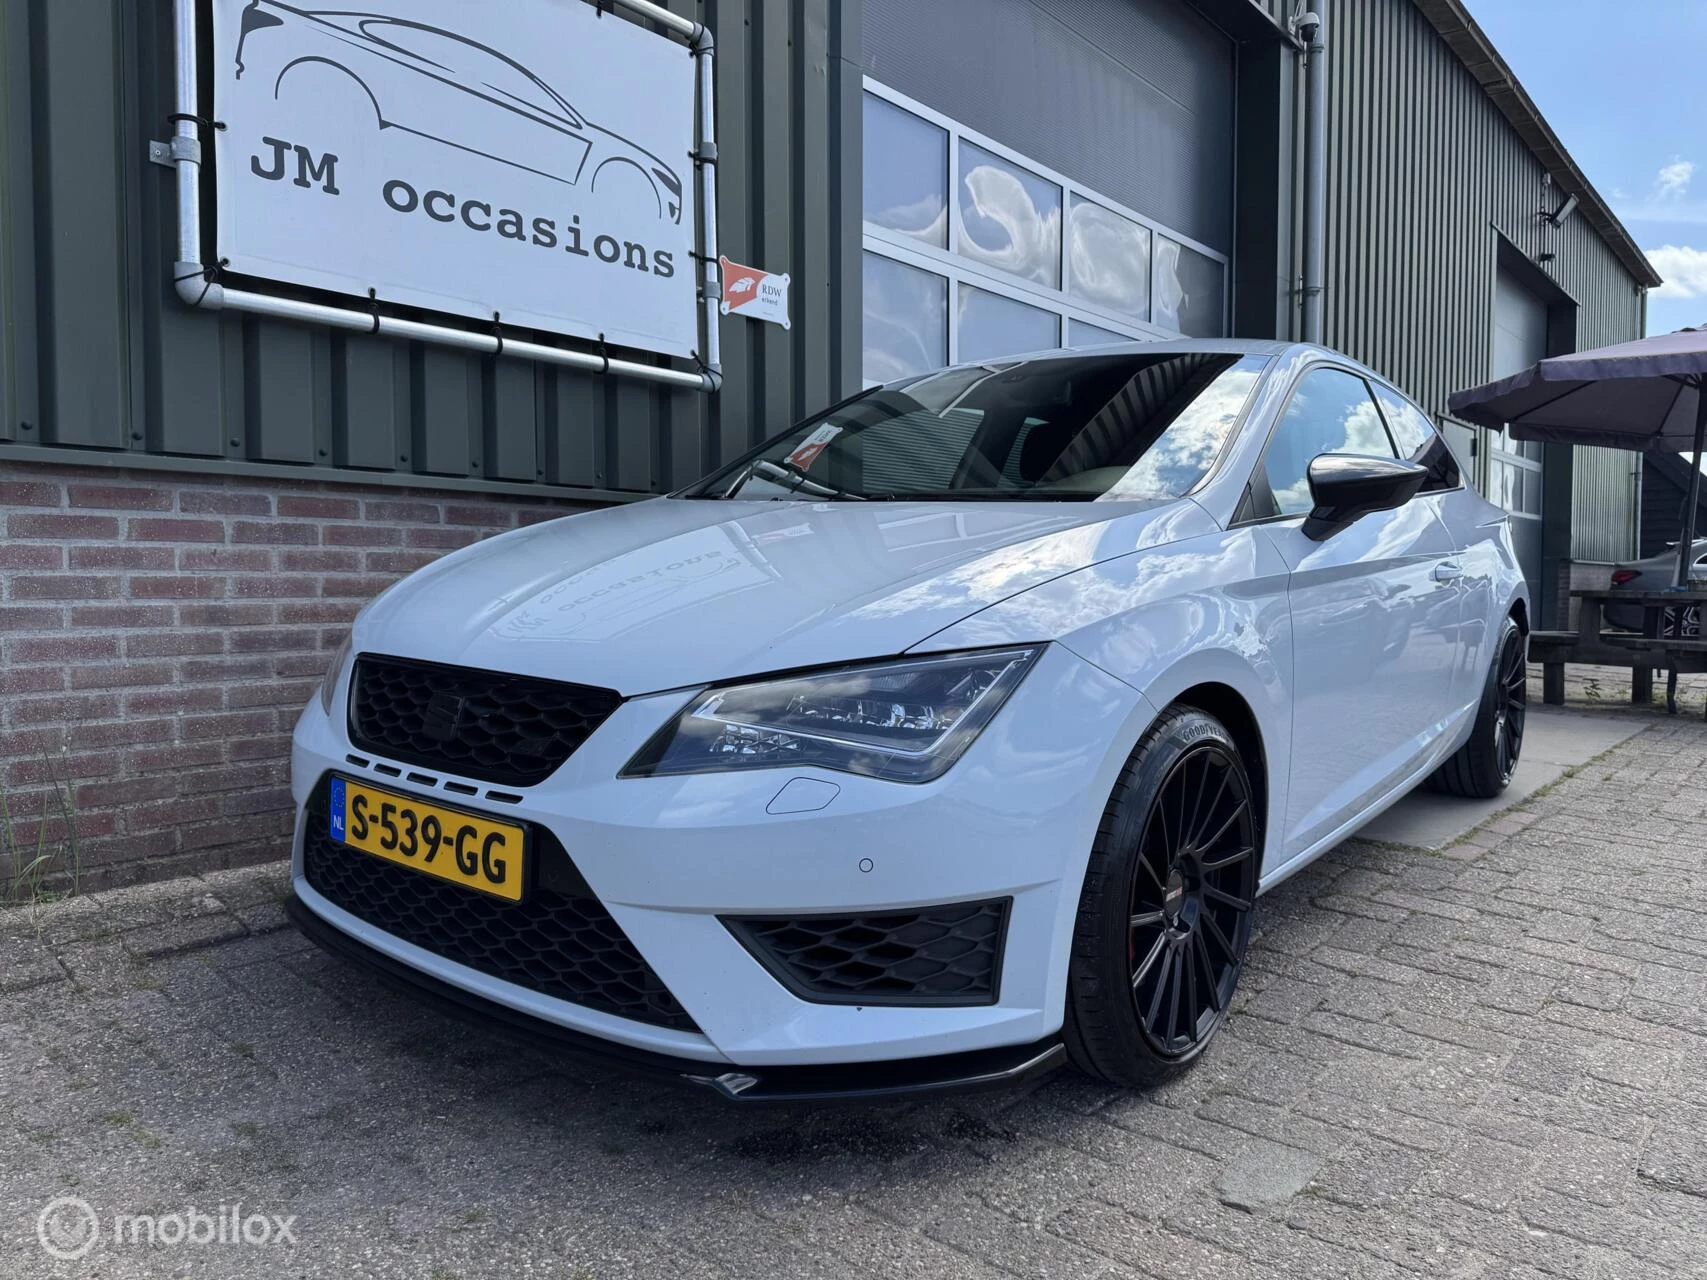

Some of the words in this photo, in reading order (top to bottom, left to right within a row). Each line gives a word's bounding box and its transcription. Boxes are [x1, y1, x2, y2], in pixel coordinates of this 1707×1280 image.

[250, 136, 340, 196] JM
[382, 180, 675, 278] occasions
[762, 284, 782, 297] RDW
[333, 814, 344, 831] NL
[351, 793, 507, 885] S-539-GG
